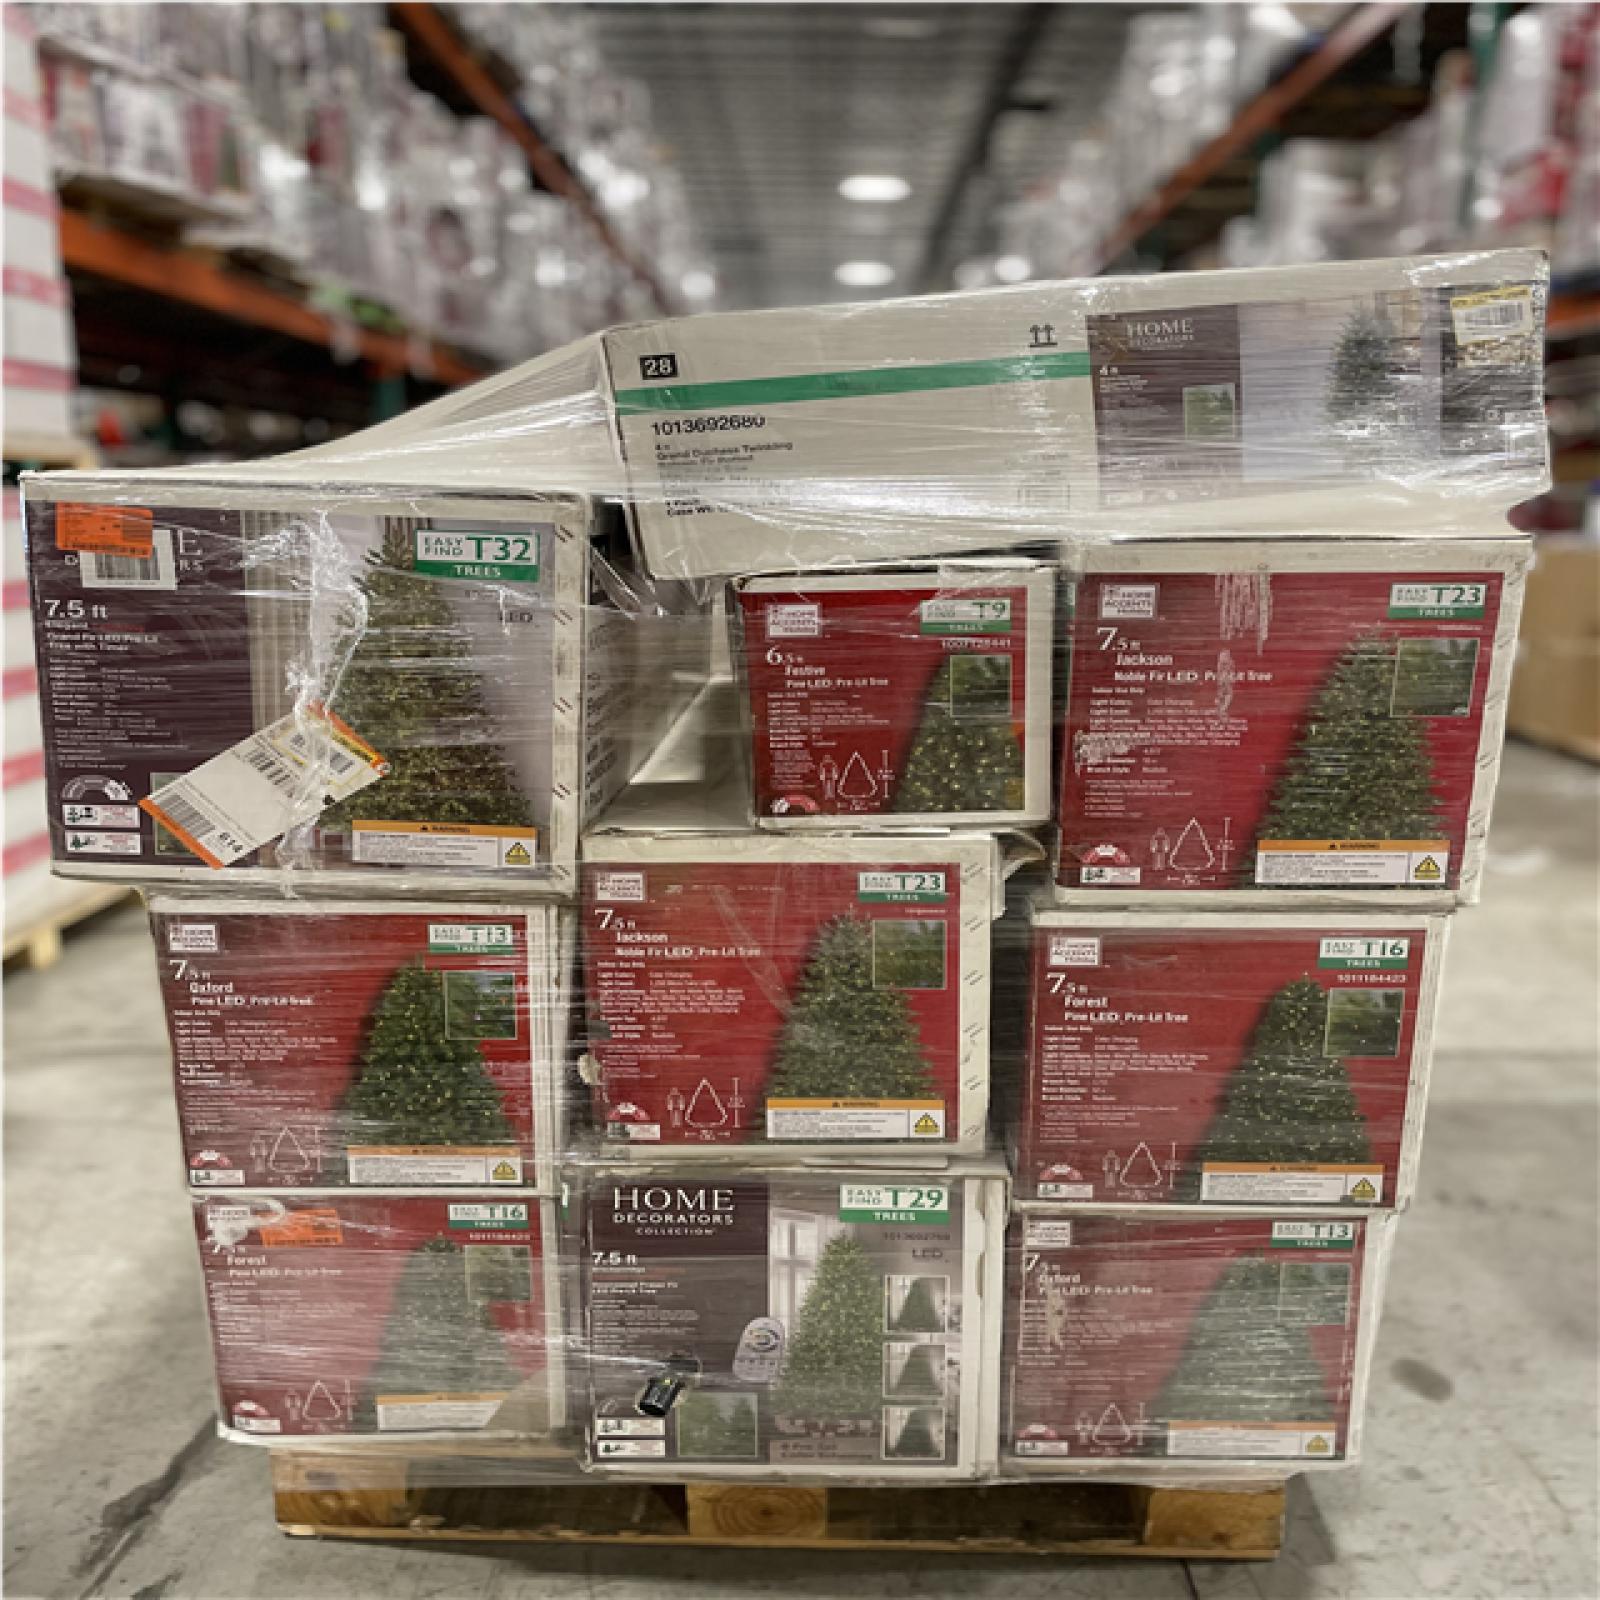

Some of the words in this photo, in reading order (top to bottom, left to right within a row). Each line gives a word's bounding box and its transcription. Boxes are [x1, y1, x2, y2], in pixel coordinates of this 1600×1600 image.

[644, 357, 672, 376] 28
[465, 536, 532, 561] T32
[454, 564, 501, 577] TREES
[1430, 585, 1482, 604] T23
[45, 599, 85, 619] 7.5
[971, 601, 1007, 619] T9
[1114, 653, 1174, 666] Jackson
[785, 665, 826, 677] Festive
[895, 874, 942, 891] T23
[465, 925, 508, 942] T13
[616, 932, 669, 943] Jackson
[1360, 939, 1404, 956] T16
[190, 982, 234, 993] Oxford
[1064, 994, 1109, 1008] Forest
[613, 1186, 735, 1211] HOME
[884, 1187, 943, 1208] T29
[483, 1205, 524, 1219] T16
[613, 1212, 734, 1225] DECORATORS
[874, 1211, 916, 1221] TREES
[1311, 1223, 1349, 1238] T13
[592, 1252, 621, 1265] 7.5
